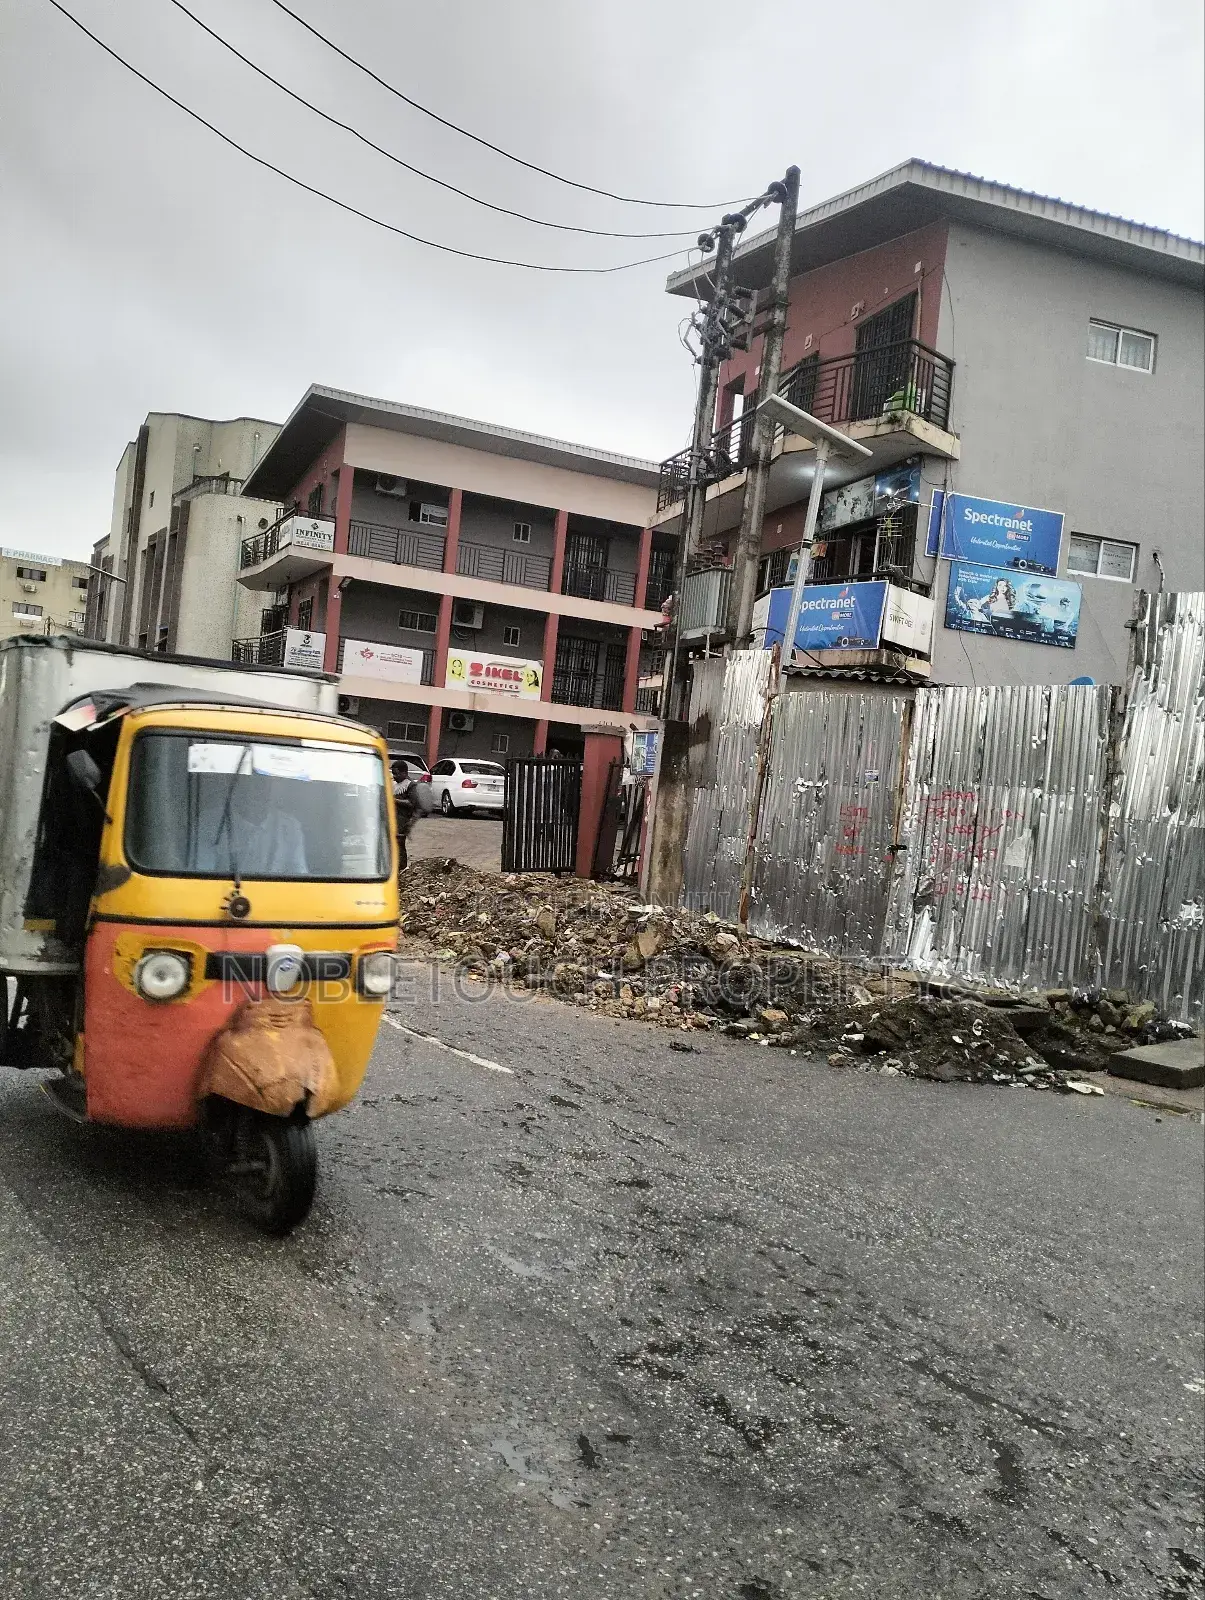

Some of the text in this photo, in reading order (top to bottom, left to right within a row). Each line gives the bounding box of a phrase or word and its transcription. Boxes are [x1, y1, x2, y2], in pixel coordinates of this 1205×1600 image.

[964, 507, 1033, 532] Spectranet
[295, 528, 333, 541] INFINITY
[13, 550, 58, 564] PHARMACY
[799, 595, 856, 614] pectranet
[889, 614, 904, 625] SWIFT
[470, 680, 519, 690] COSMETICS
